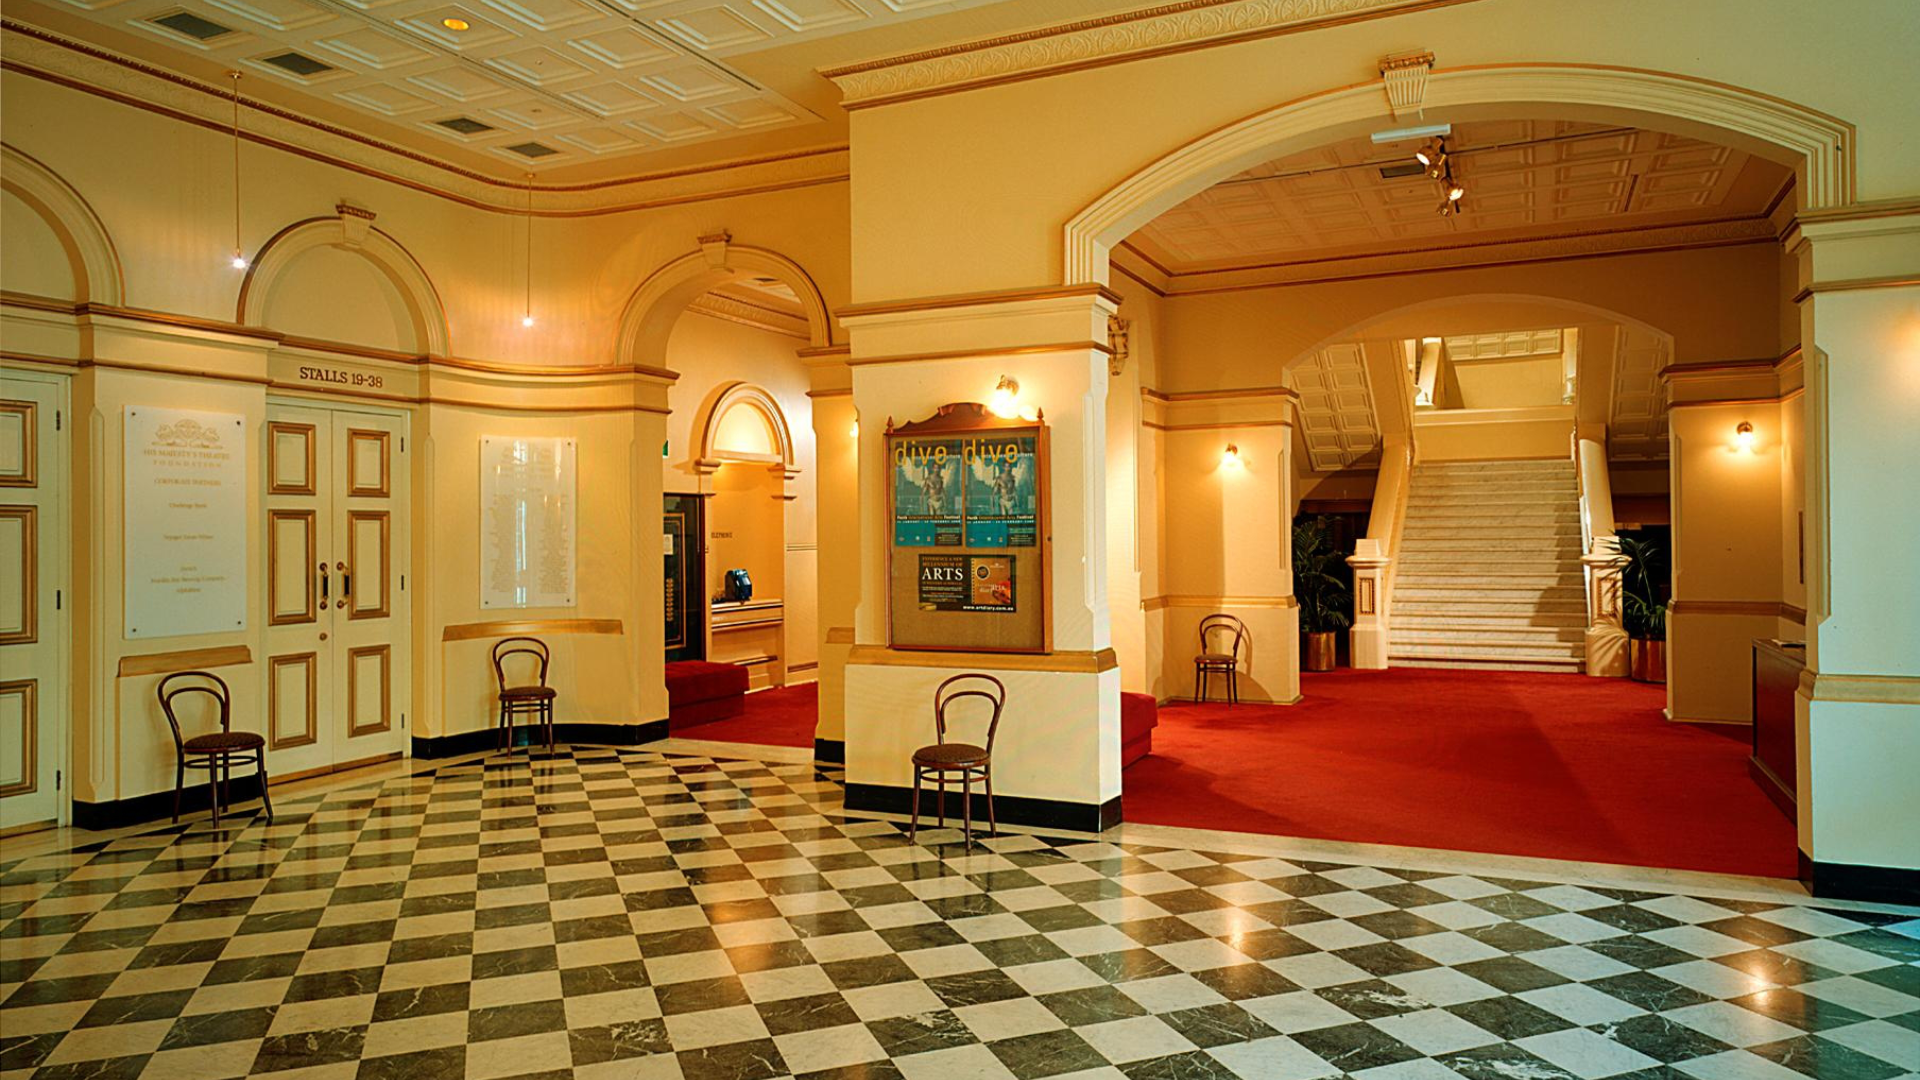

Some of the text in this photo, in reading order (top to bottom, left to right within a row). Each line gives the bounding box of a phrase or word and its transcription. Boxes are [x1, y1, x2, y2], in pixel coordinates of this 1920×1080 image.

[299, 366, 383, 388] STALLS 19-38
[895, 440, 947, 466] dive
[965, 438, 1018, 466] dive
[921, 567, 964, 581] ARTS
